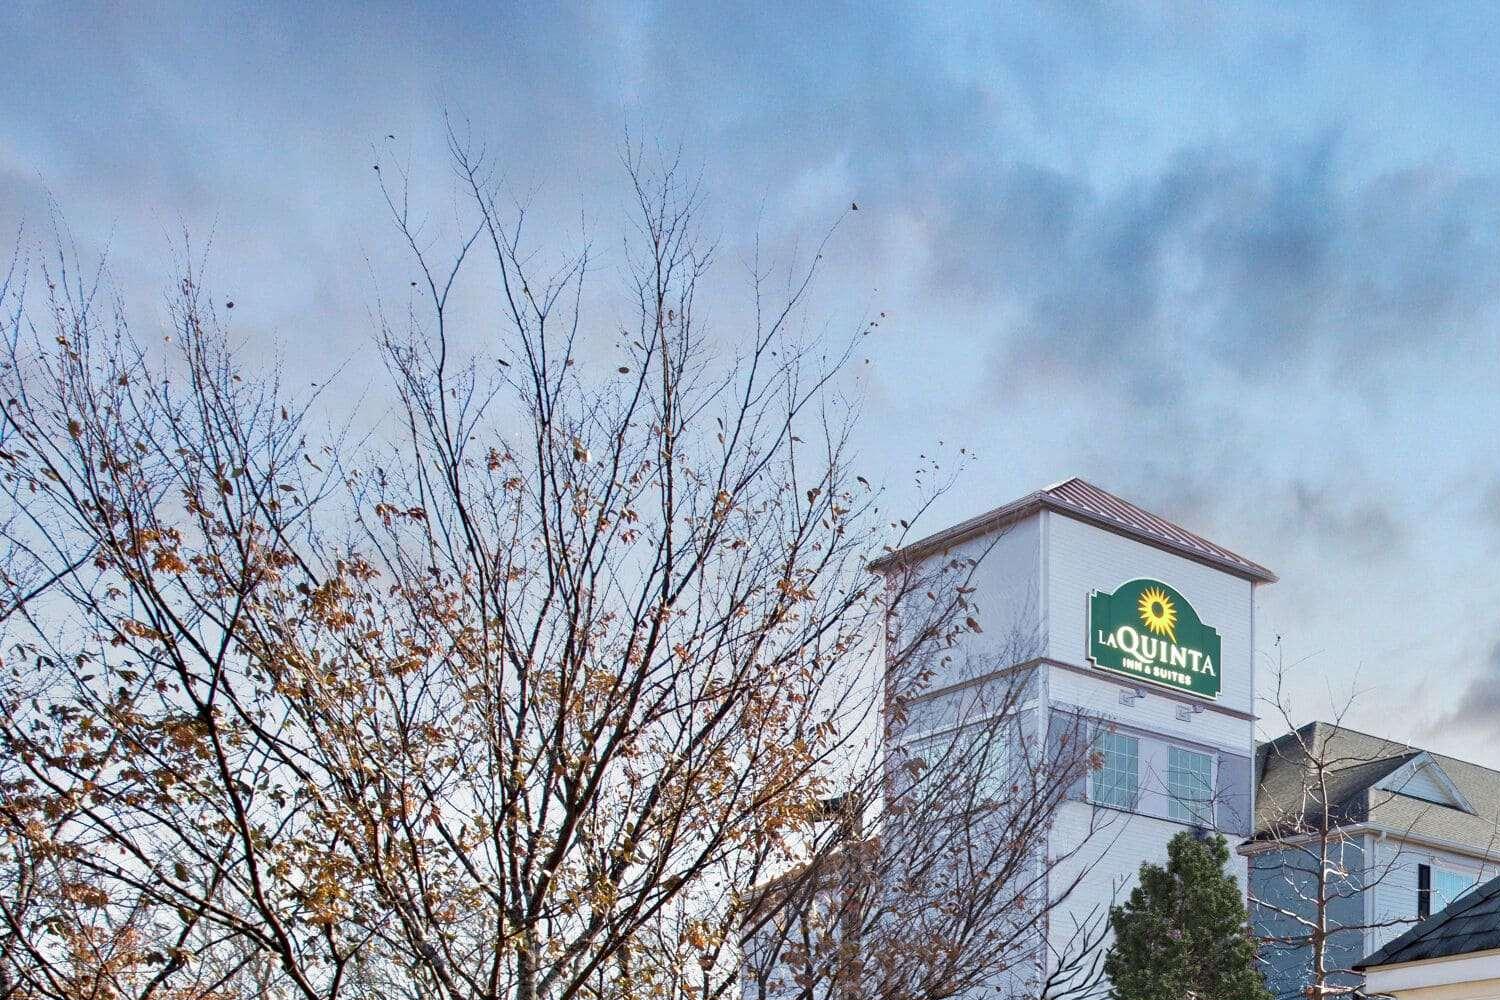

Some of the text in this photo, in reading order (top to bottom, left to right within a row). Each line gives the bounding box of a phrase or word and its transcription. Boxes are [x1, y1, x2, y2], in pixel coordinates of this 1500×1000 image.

[1098, 625, 1216, 677] LA QUINTA
[1122, 657, 1192, 686] INN & SUITES
